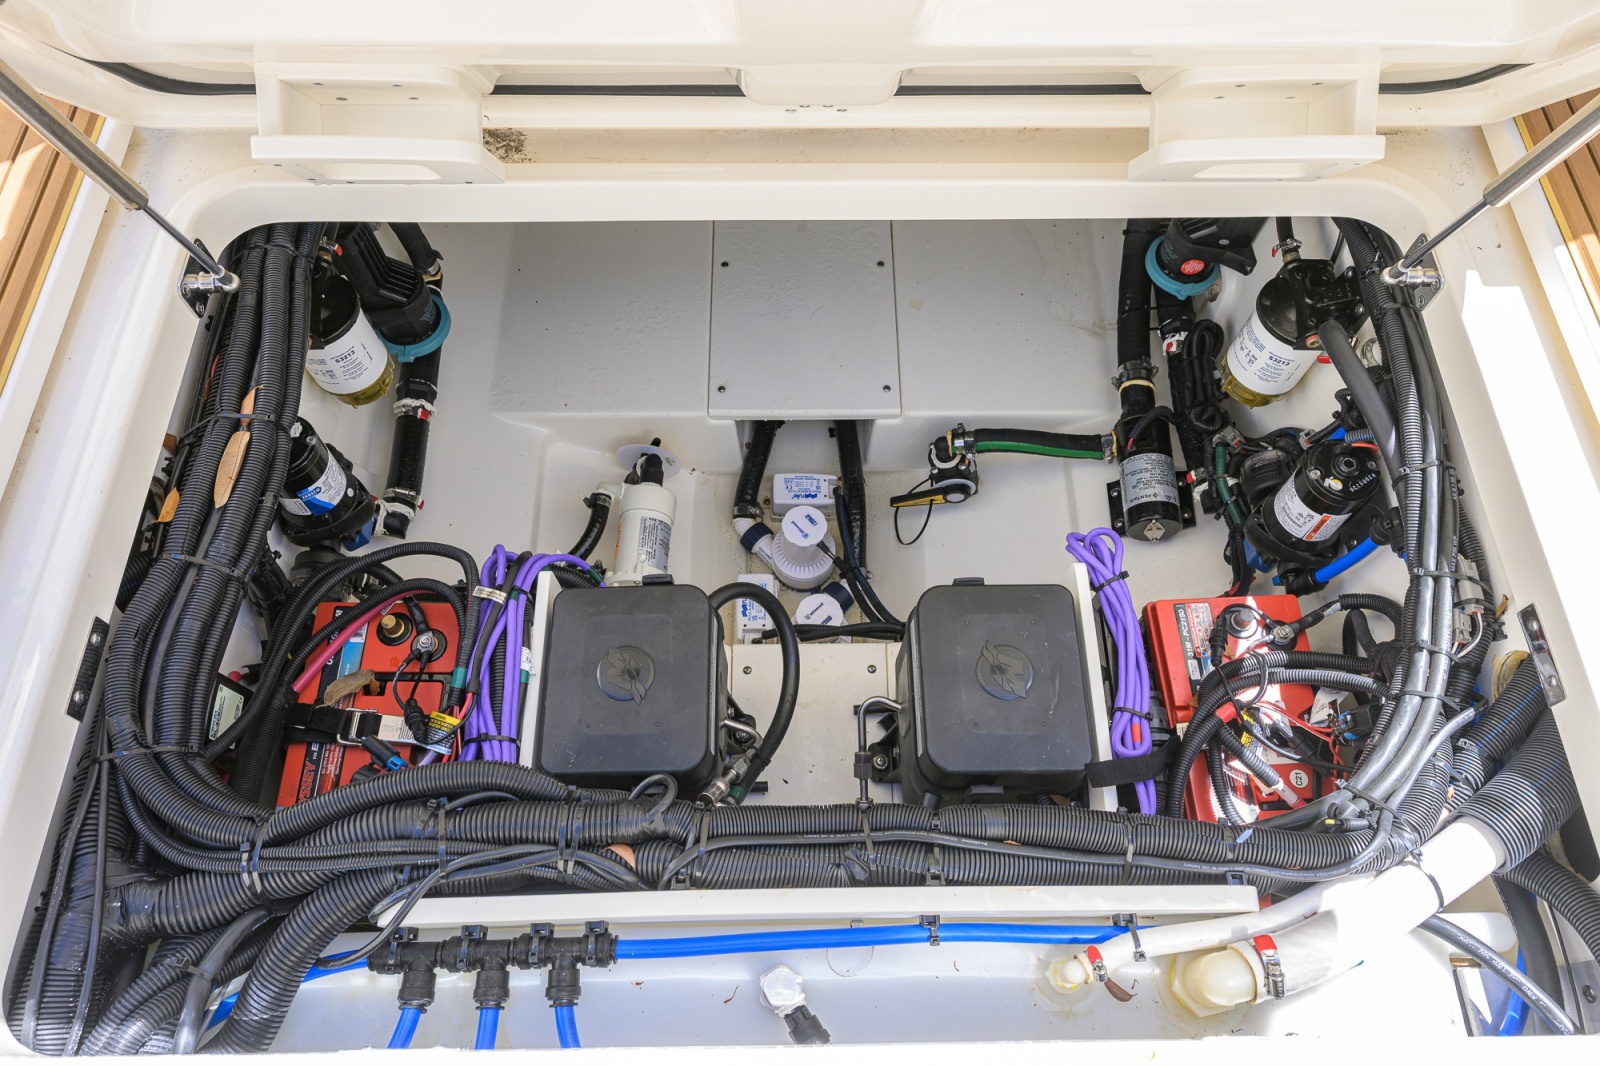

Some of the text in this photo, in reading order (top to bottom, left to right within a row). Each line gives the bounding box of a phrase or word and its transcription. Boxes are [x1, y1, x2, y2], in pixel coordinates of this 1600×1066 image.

[1268, 356, 1290, 366] S3213
[1130, 494, 1152, 503] PENTAIR
[1178, 609, 1189, 637] PC2150
[1185, 642, 1194, 657] 31M
[299, 760, 316, 802] YSSEY
[1295, 772, 1303, 786] C21
[1478, 948, 1491, 959] 50V
[1522, 985, 1538, 1000] AWG
